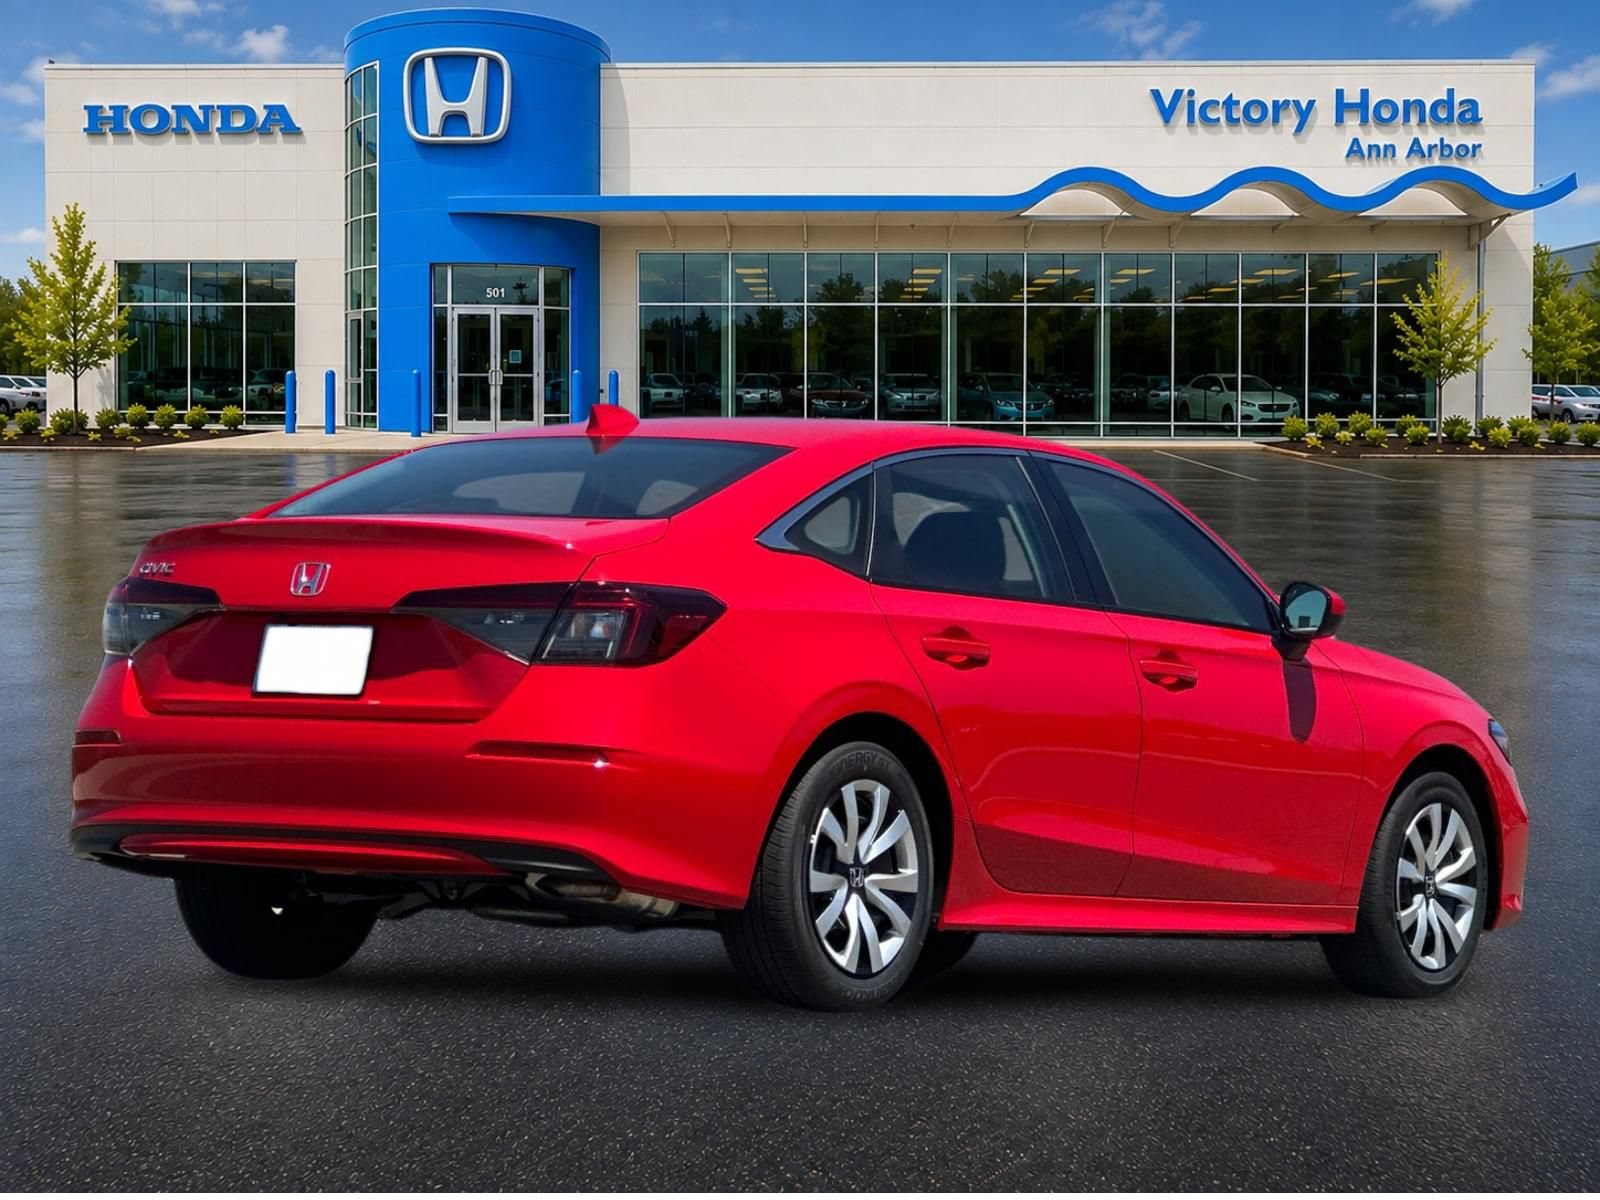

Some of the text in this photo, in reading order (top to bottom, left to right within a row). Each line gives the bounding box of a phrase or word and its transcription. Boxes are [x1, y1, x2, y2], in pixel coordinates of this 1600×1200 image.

[82, 103, 302, 135] HONDA
[1150, 87, 1482, 135] Victory Honda
[1345, 137, 1482, 159] Ann Arbor
[486, 287, 505, 298] 501
